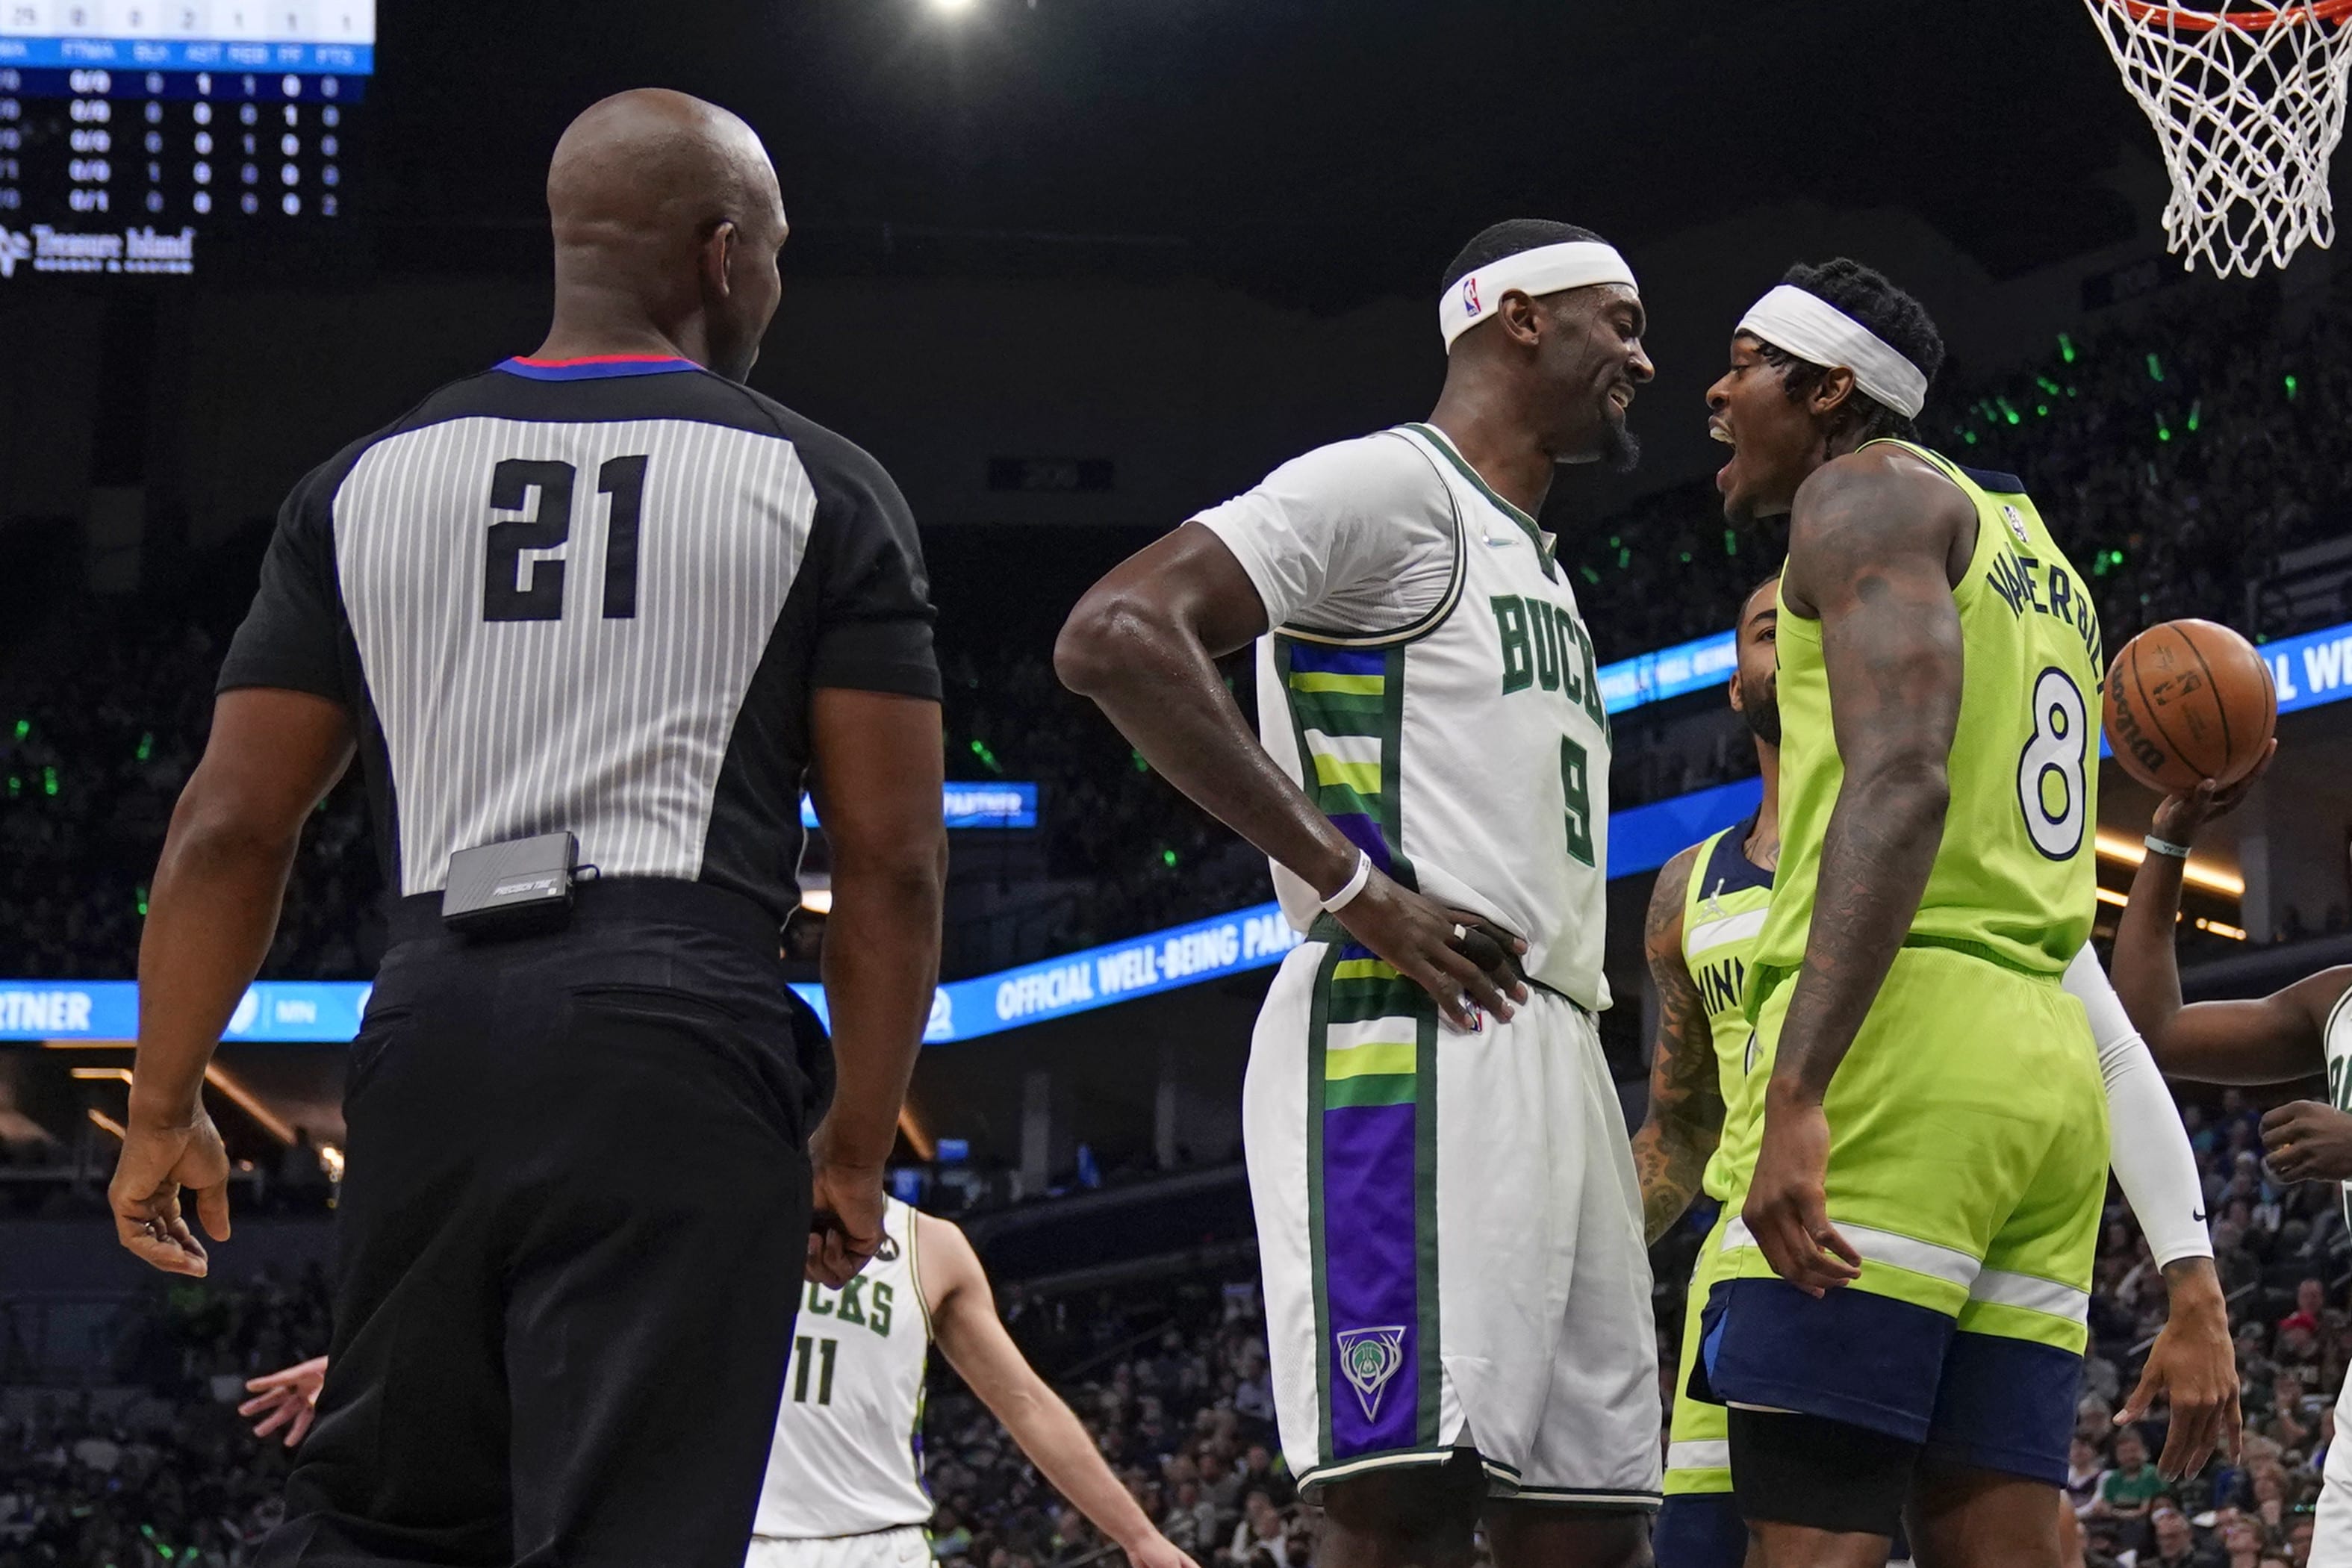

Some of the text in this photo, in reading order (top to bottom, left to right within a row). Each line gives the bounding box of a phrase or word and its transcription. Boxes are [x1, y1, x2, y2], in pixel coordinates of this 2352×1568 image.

[484, 455, 649, 621] 21
[1490, 594, 1611, 756] BUCK
[1561, 732, 1596, 868] 9
[2017, 667, 2087, 862] 8
[996, 910, 1305, 1020] OFFICIAL WELL-BEING PAR
[794, 1336, 838, 1405] 11
[800, 1274, 894, 1337] CKS
